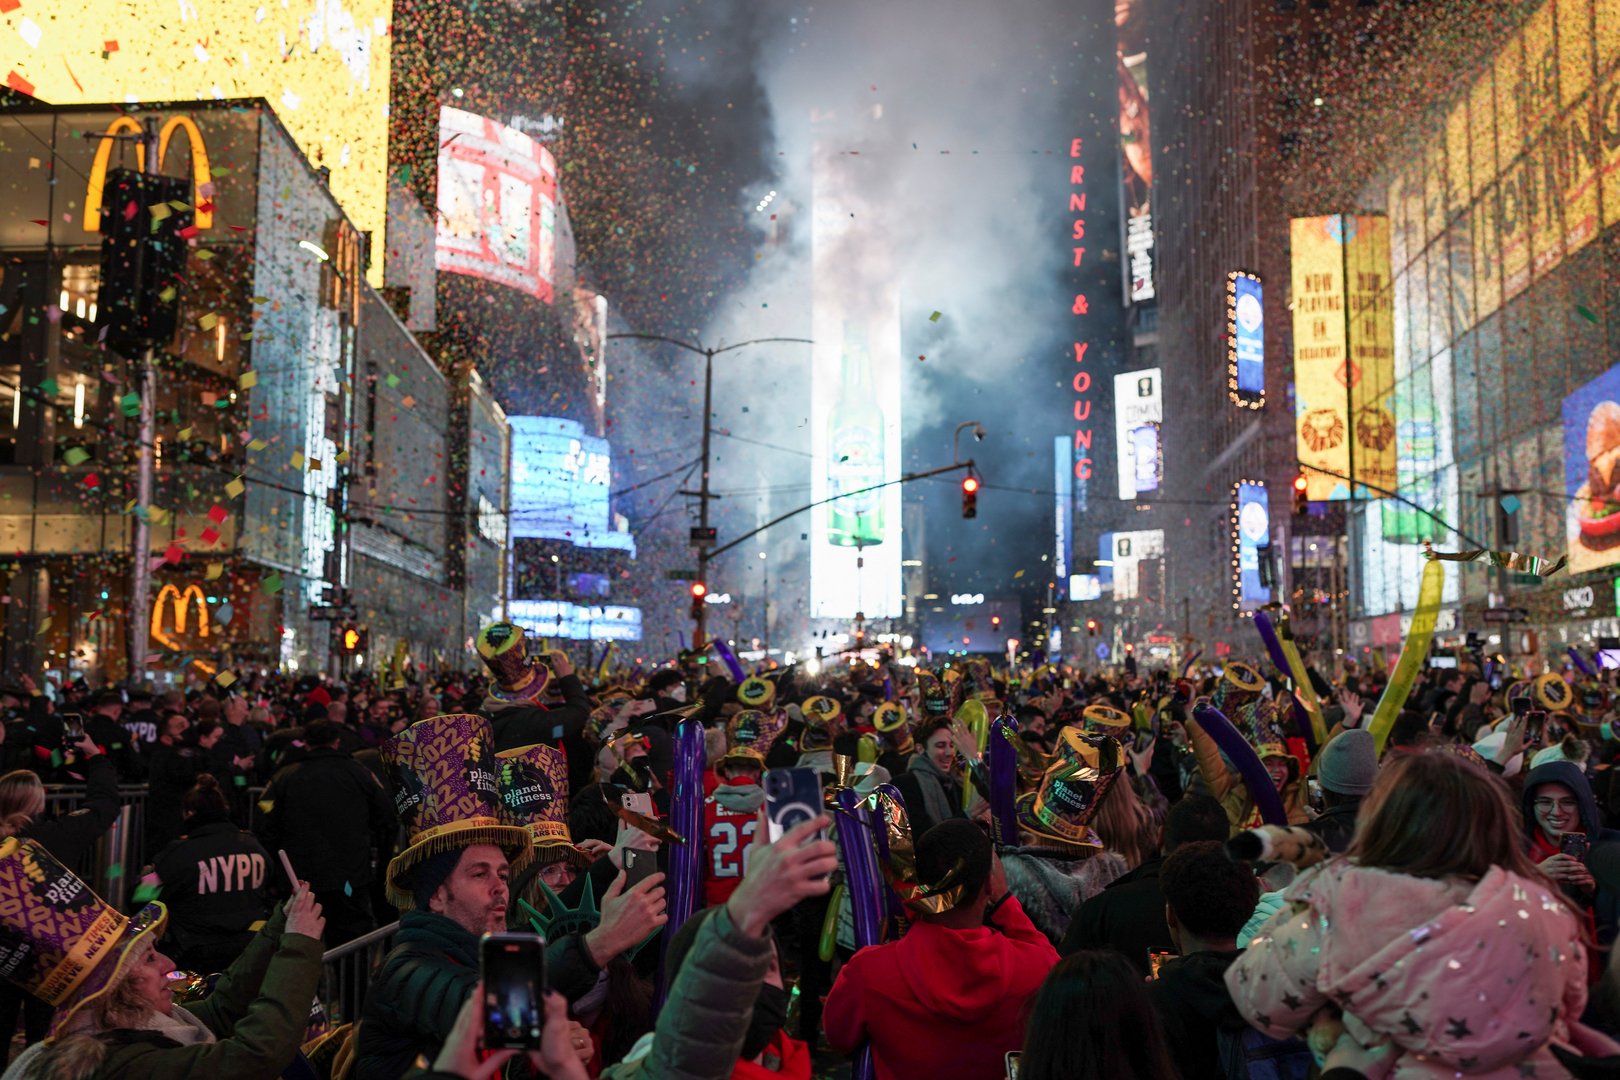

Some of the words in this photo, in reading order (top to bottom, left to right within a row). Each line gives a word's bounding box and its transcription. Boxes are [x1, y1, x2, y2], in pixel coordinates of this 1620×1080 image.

[1068, 138, 1087, 267] ERNST
[1072, 294, 1088, 315] &
[1072, 342, 1093, 481] YOUNG
[470, 768, 496, 782] plan
[503, 783, 543, 803] planet
[510, 793, 552, 808] fitness
[1053, 780, 1083, 801] planet
[1055, 787, 1087, 810] fitness
[531, 830, 550, 838] ARS
[533, 823, 564, 832] SQUARE
[198, 853, 265, 894] NYPD
[84, 934, 107, 960] NEW
